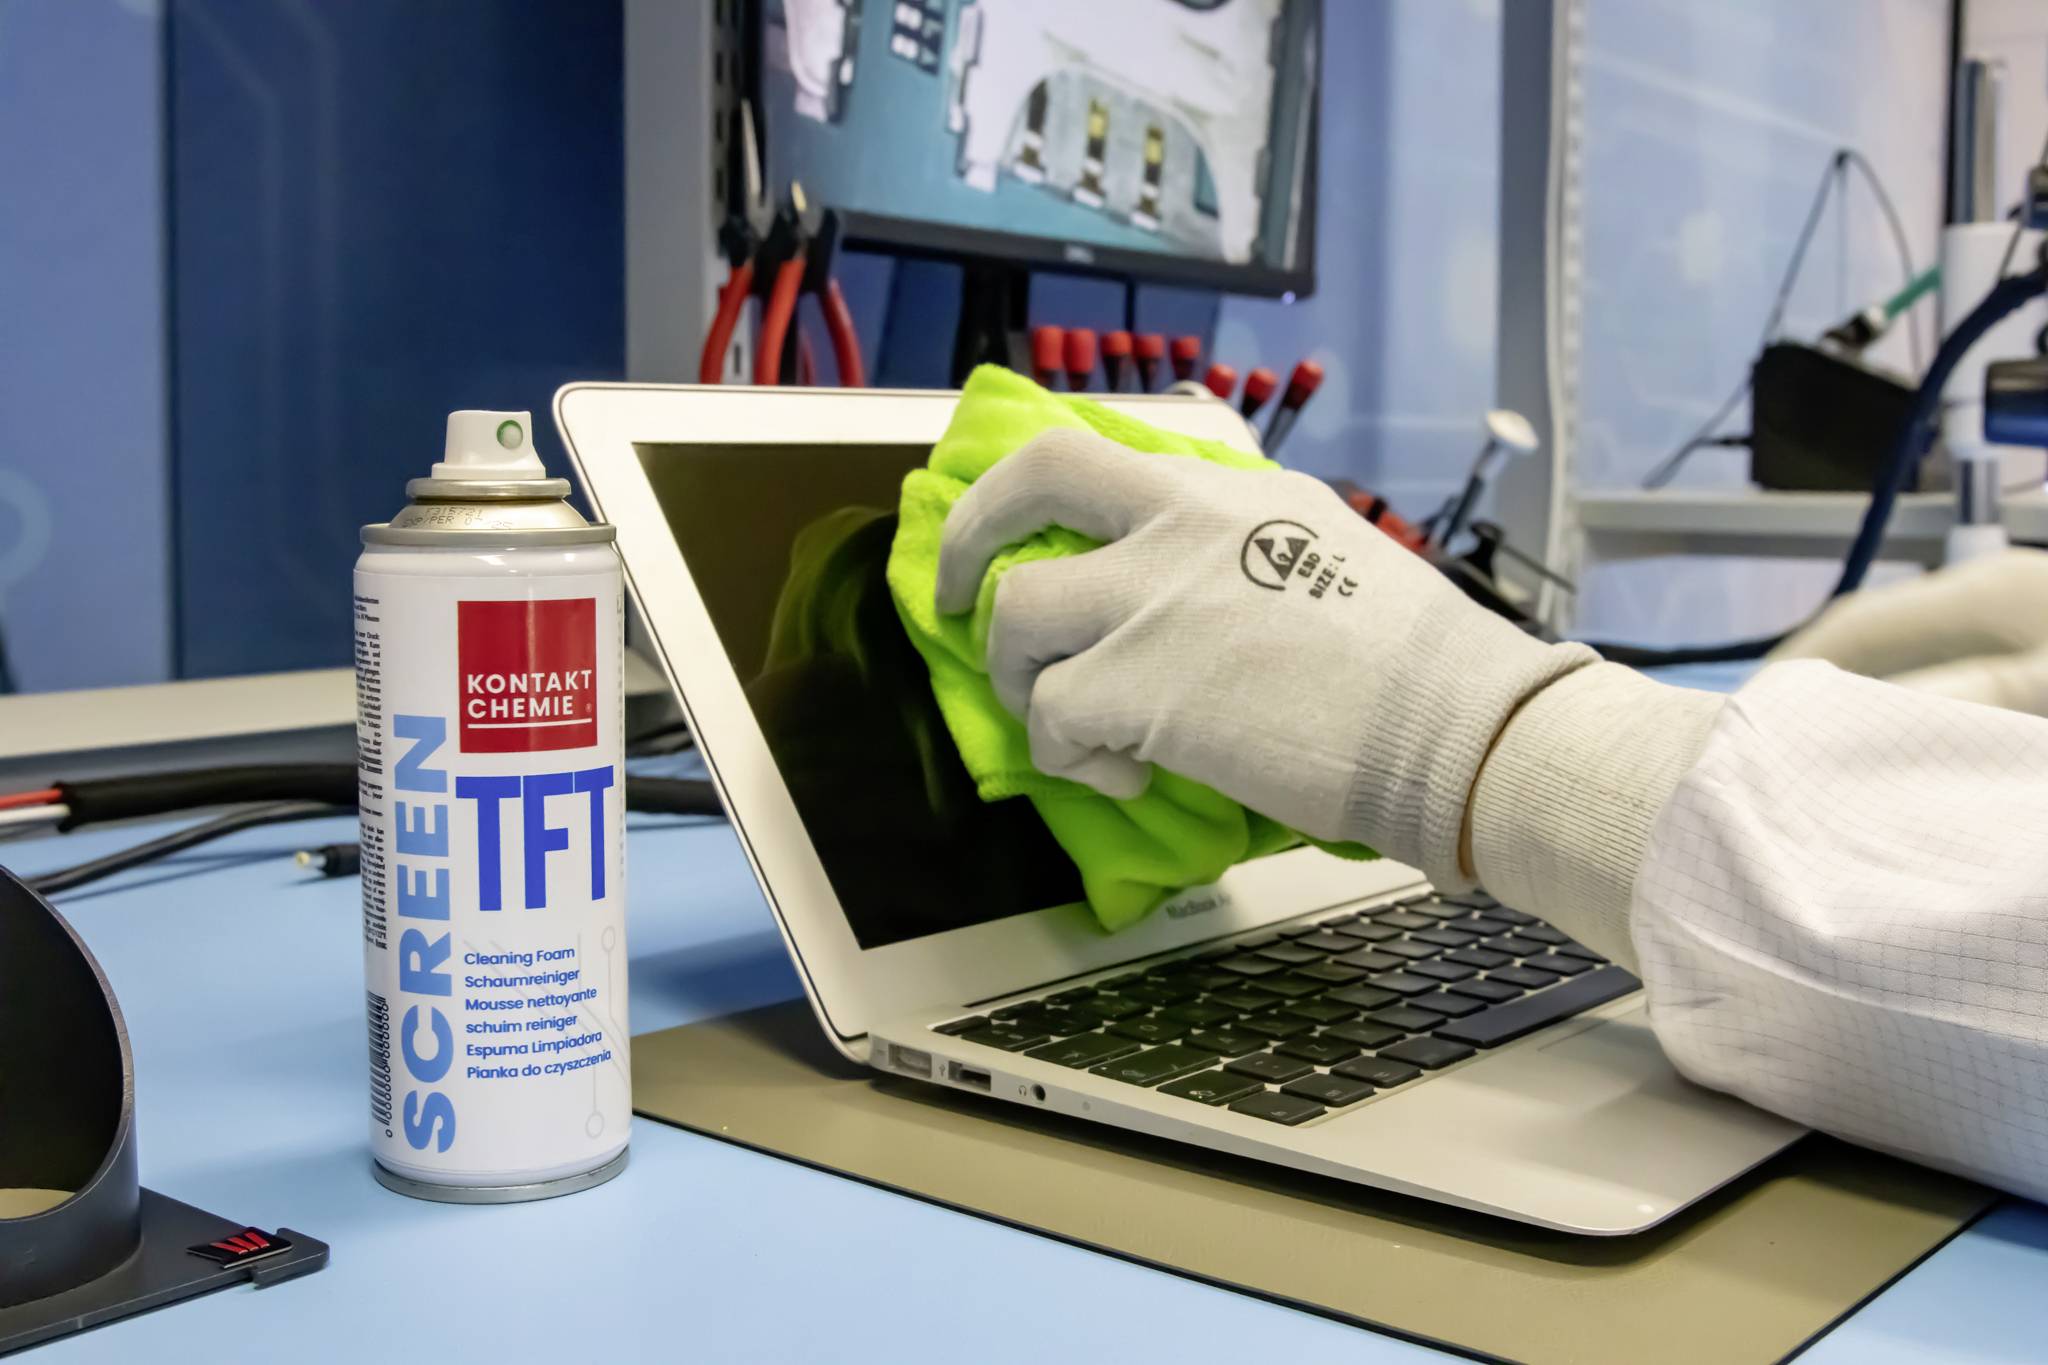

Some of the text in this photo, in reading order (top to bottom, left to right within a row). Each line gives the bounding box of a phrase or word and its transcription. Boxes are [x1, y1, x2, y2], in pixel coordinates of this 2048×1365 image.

[1297, 552, 1321, 578] ESD
[467, 669, 593, 695] KONTAKT
[467, 695, 574, 719] CHEMIE
[455, 764, 614, 912] TFT
[393, 713, 457, 1154] SCREEN
[464, 948, 576, 967] Cleaning Foam
[464, 968, 580, 988] Schaumreiniger
[465, 987, 597, 1011] Mousse nettoyante
[465, 1014, 578, 1034] schuim reiniger
[466, 1031, 602, 1060] Espuma Limpiadora
[467, 1049, 612, 1079] Pianka do czyszczenia
